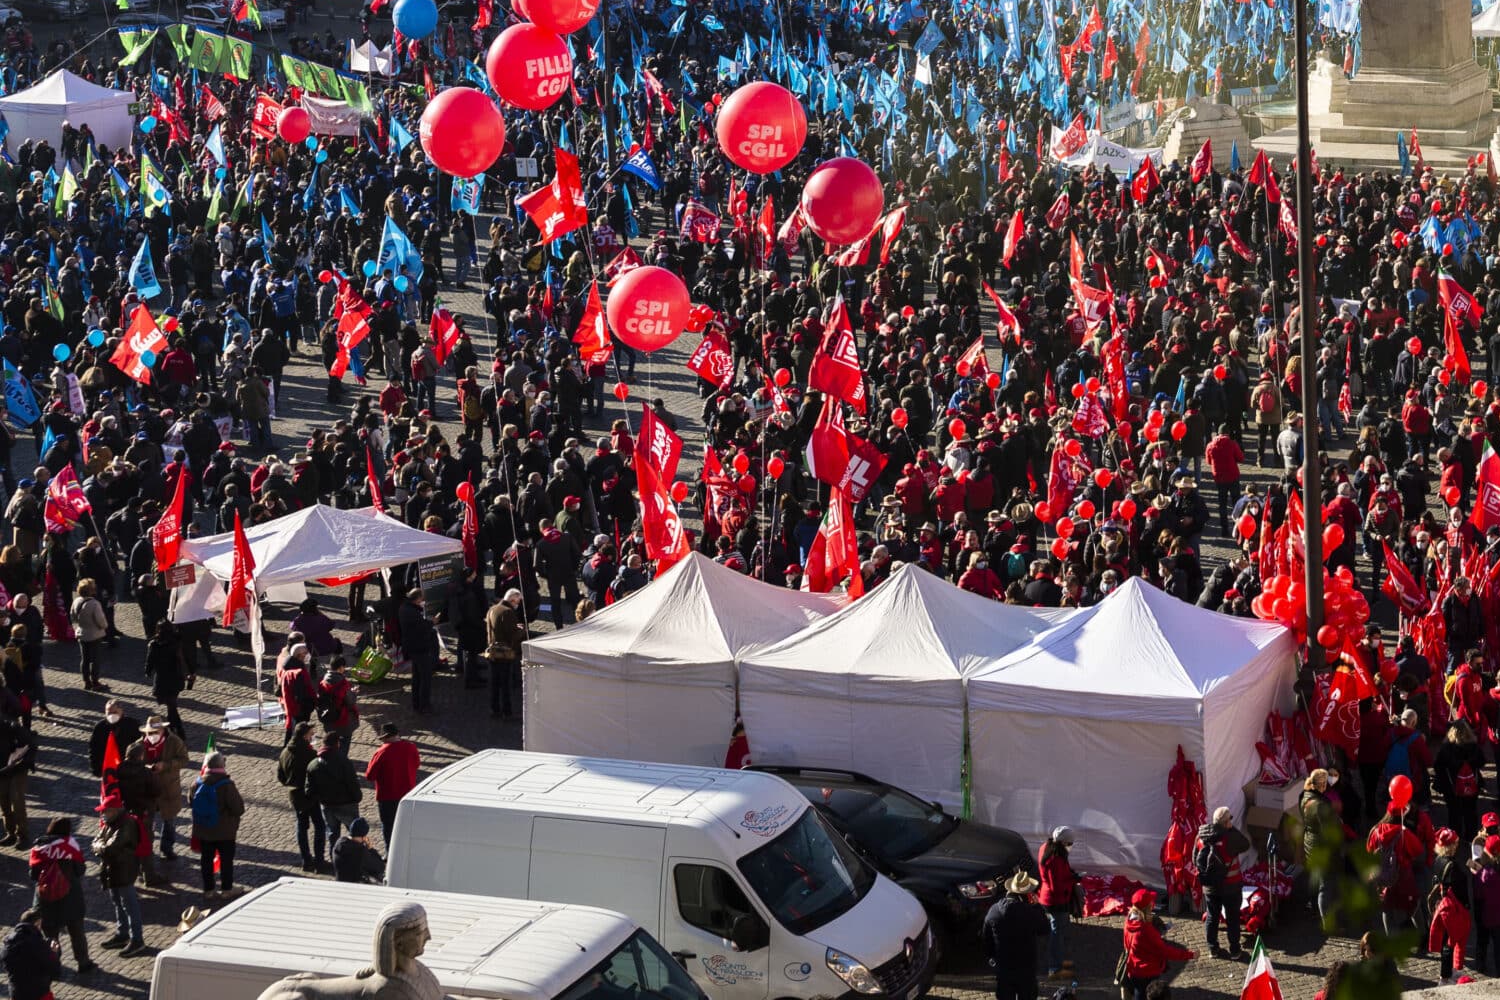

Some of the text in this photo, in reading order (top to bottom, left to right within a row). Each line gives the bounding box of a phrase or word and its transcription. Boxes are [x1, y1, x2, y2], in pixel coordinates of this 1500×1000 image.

[747, 124, 782, 141] SPI
[738, 140, 787, 159] CGIL
[634, 300, 669, 318] SPI
[625, 317, 672, 336] CGIL
